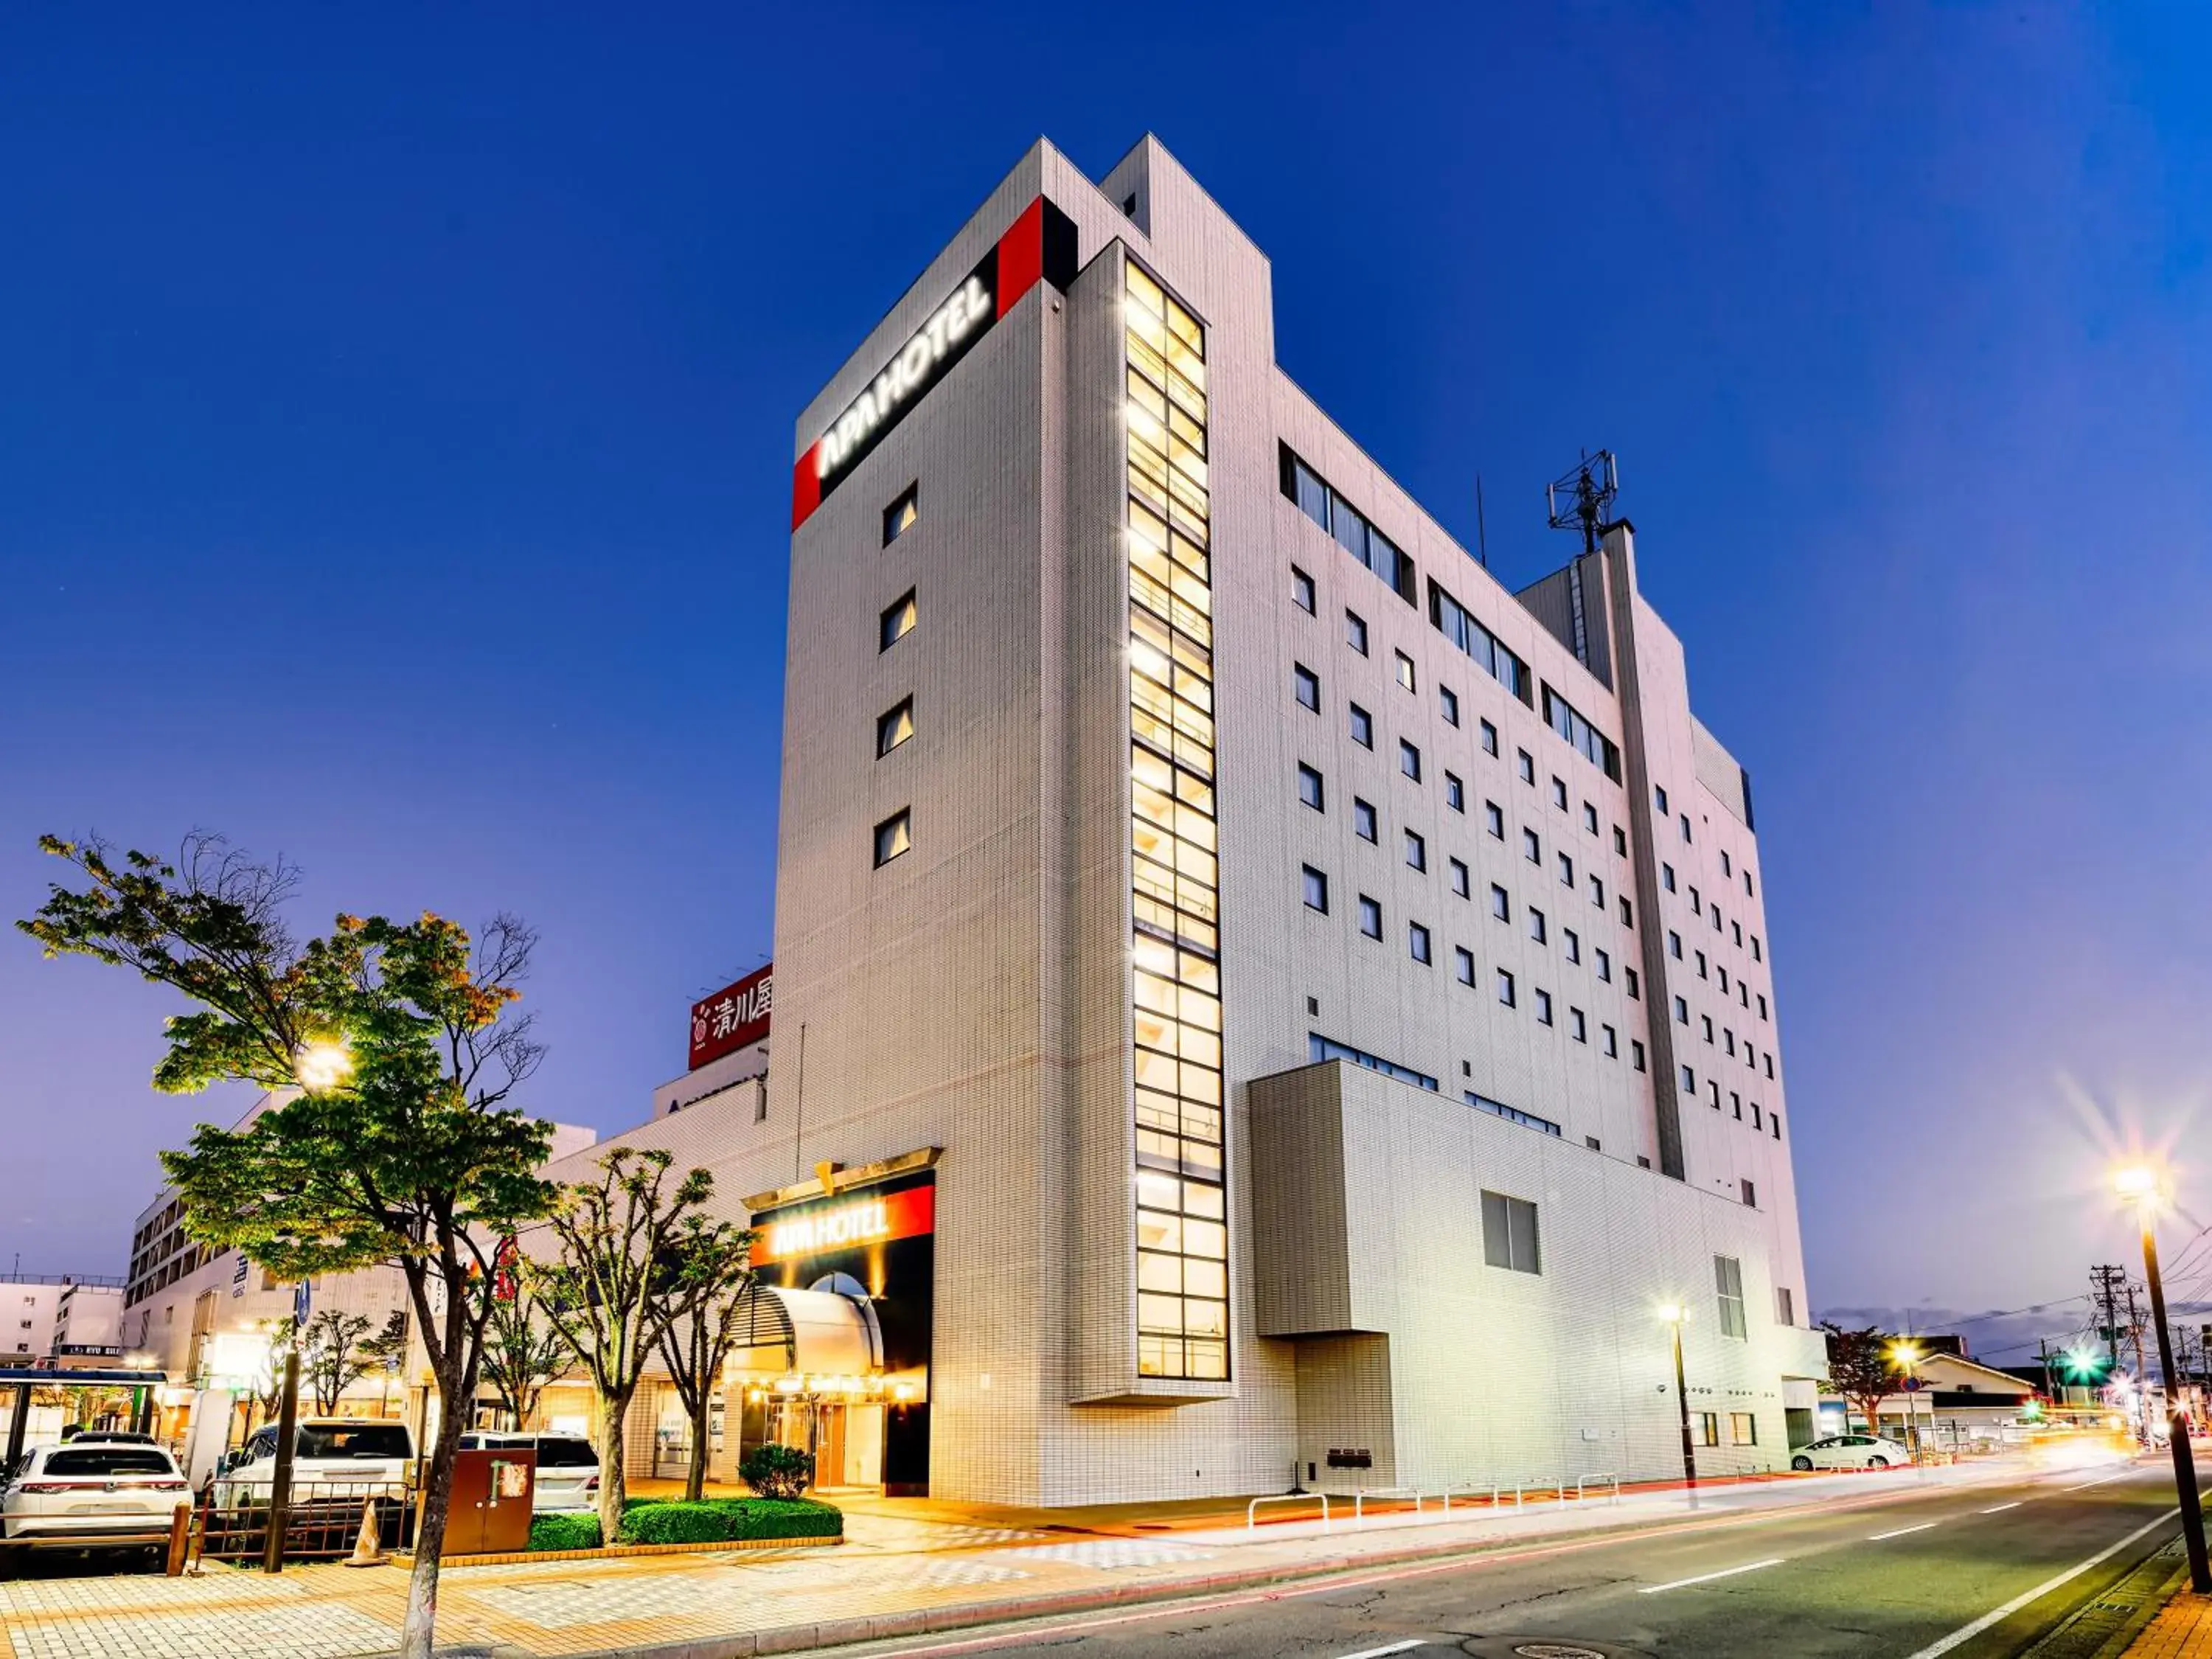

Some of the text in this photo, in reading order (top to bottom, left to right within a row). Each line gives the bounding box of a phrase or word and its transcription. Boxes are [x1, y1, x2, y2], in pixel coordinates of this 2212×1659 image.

[818, 276, 990, 478] APA HOTEL
[712, 975, 772, 1039] 清川屋
[815, 1203, 889, 1245] HOTEL
